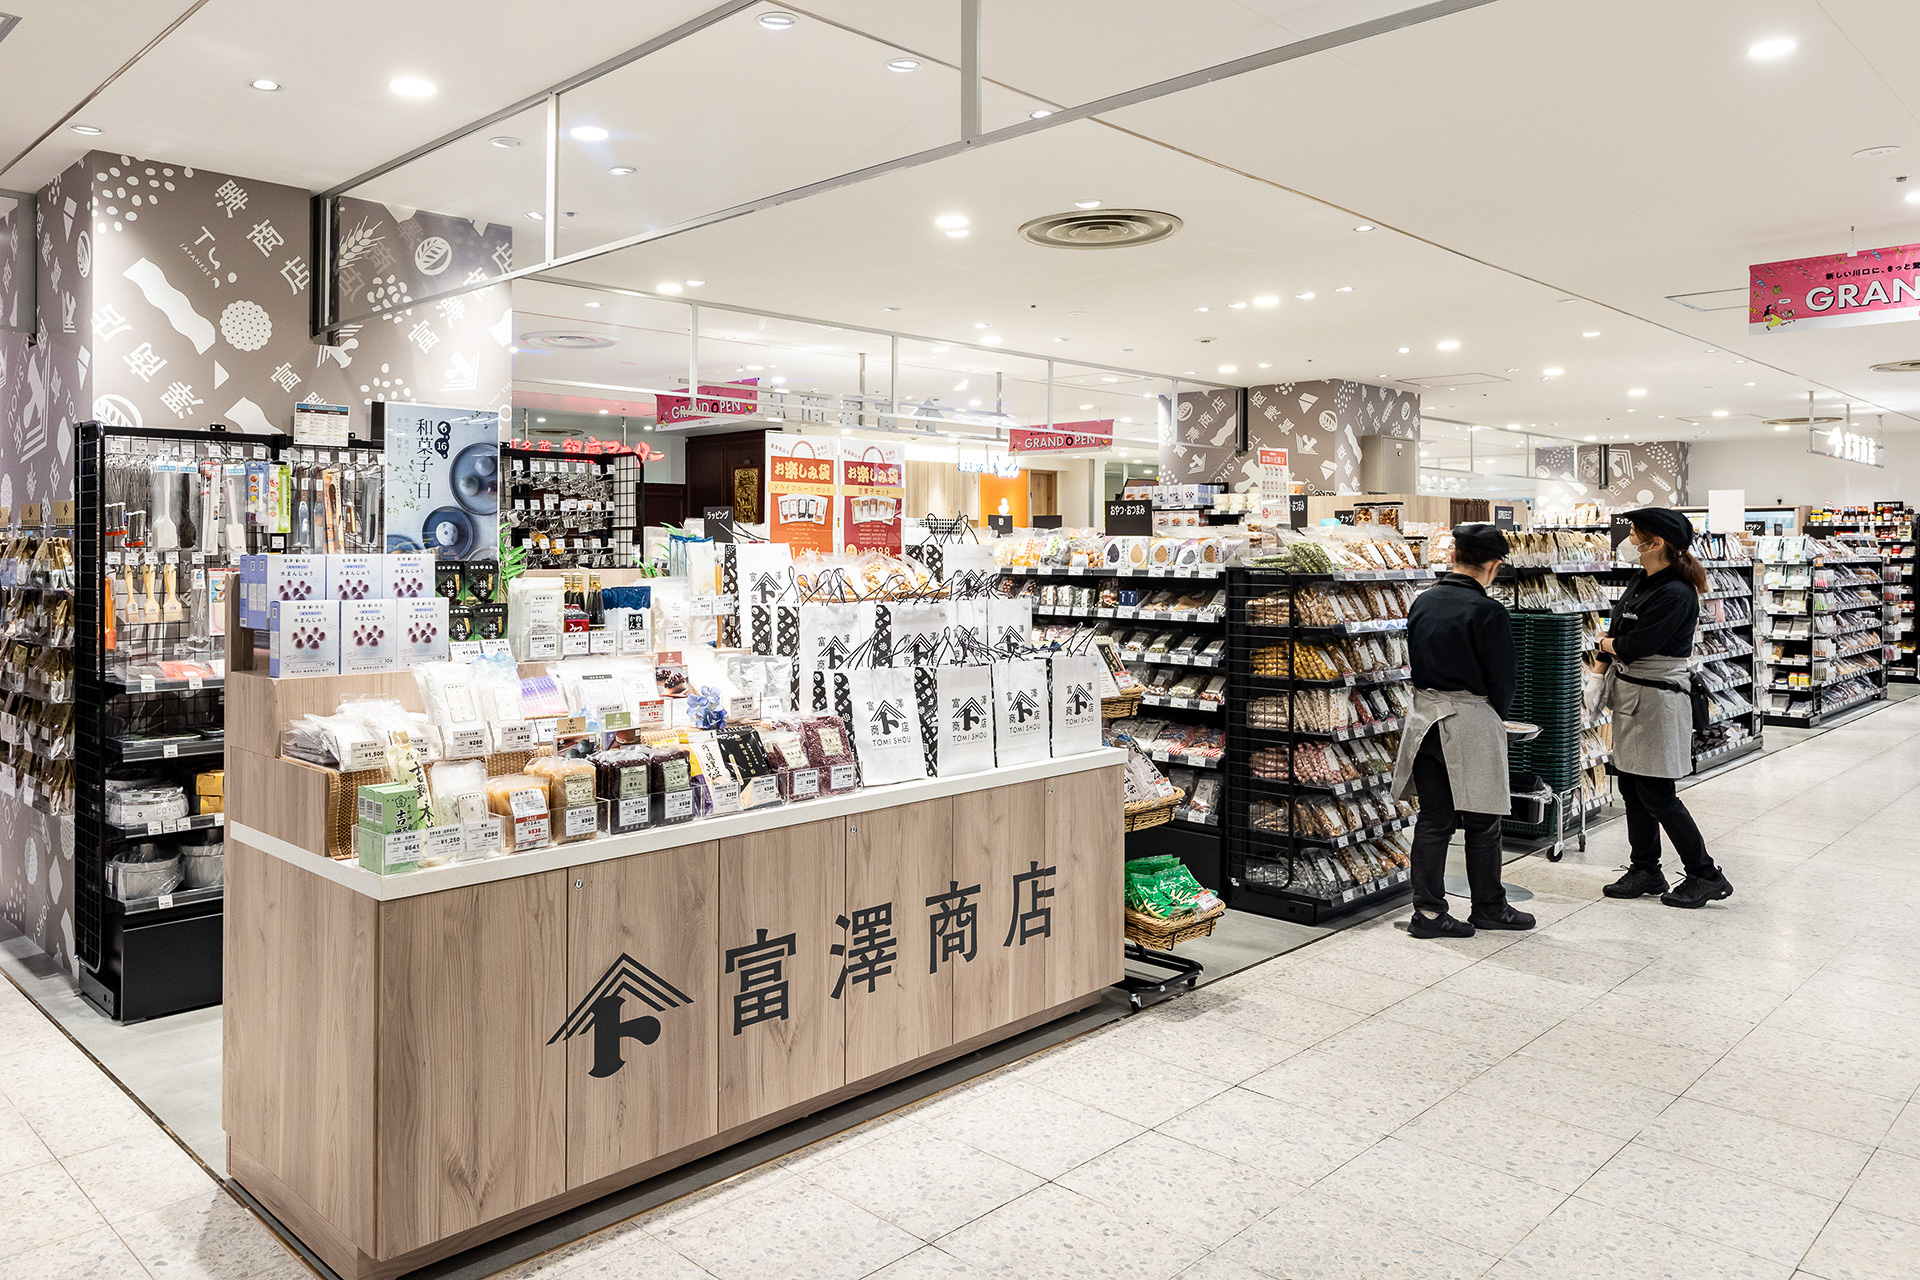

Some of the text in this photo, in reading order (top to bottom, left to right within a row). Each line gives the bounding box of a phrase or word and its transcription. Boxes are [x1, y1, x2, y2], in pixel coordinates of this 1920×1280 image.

[671, 402, 710, 419] GRAD
[437, 441, 447, 450] 16
[1024, 435, 1096, 449] GRAND OPEN
[416, 418, 434, 499] 和菓子の日
[774, 461, 831, 481] お楽しみ袋
[847, 465, 899, 484] お楽しみ袋
[774, 483, 831, 494] ドライフルーツセット
[706, 510, 729, 520] ラッピング
[1110, 504, 1146, 516] おやつ・おつまみ
[446, 580, 455, 598] 抹茶
[479, 579, 488, 597] 抹茶
[456, 623, 466, 640] 抹茶
[489, 623, 497, 639] 抹茶
[1065, 715, 1095, 725] TOMI SHOU
[1009, 723, 1041, 734] TOMI SHOU
[872, 735, 912, 747] TOMI SHOU
[952, 732, 988, 742] TOMI SHOU
[440, 836, 461, 845] ¥1,250
[725, 861, 1057, 1036] 富澤商店
